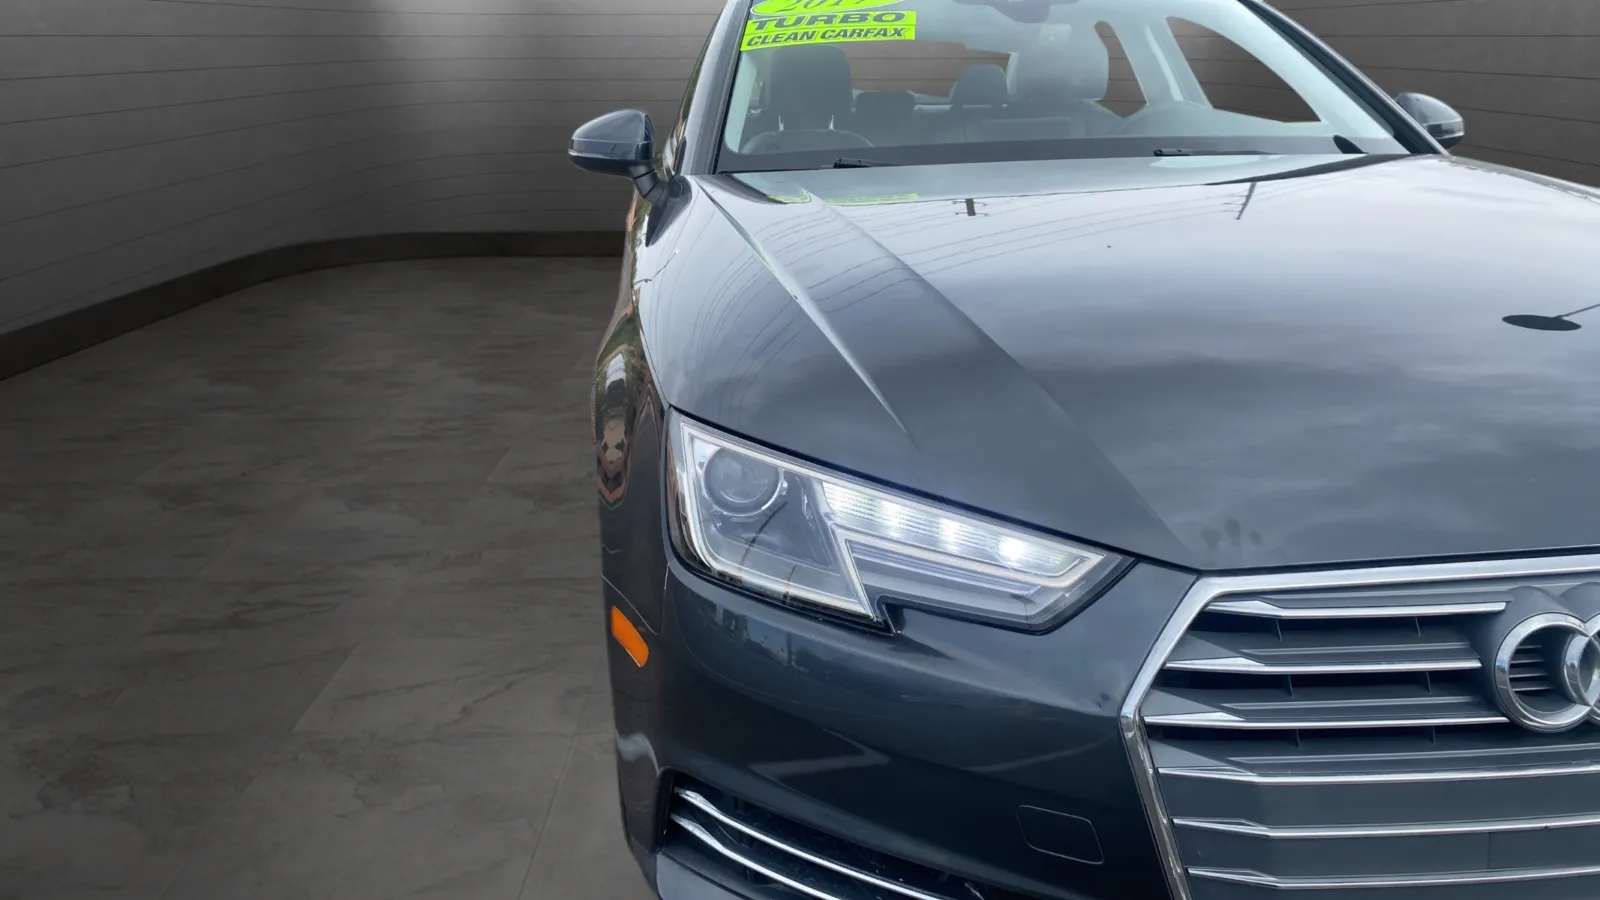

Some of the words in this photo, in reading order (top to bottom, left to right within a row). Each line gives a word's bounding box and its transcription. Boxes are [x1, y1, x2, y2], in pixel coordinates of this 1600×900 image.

[775, 0, 865, 12] 201
[752, 12, 906, 31] TURBO
[747, 31, 814, 46] CLEAN
[820, 27, 905, 39] CARFAX
